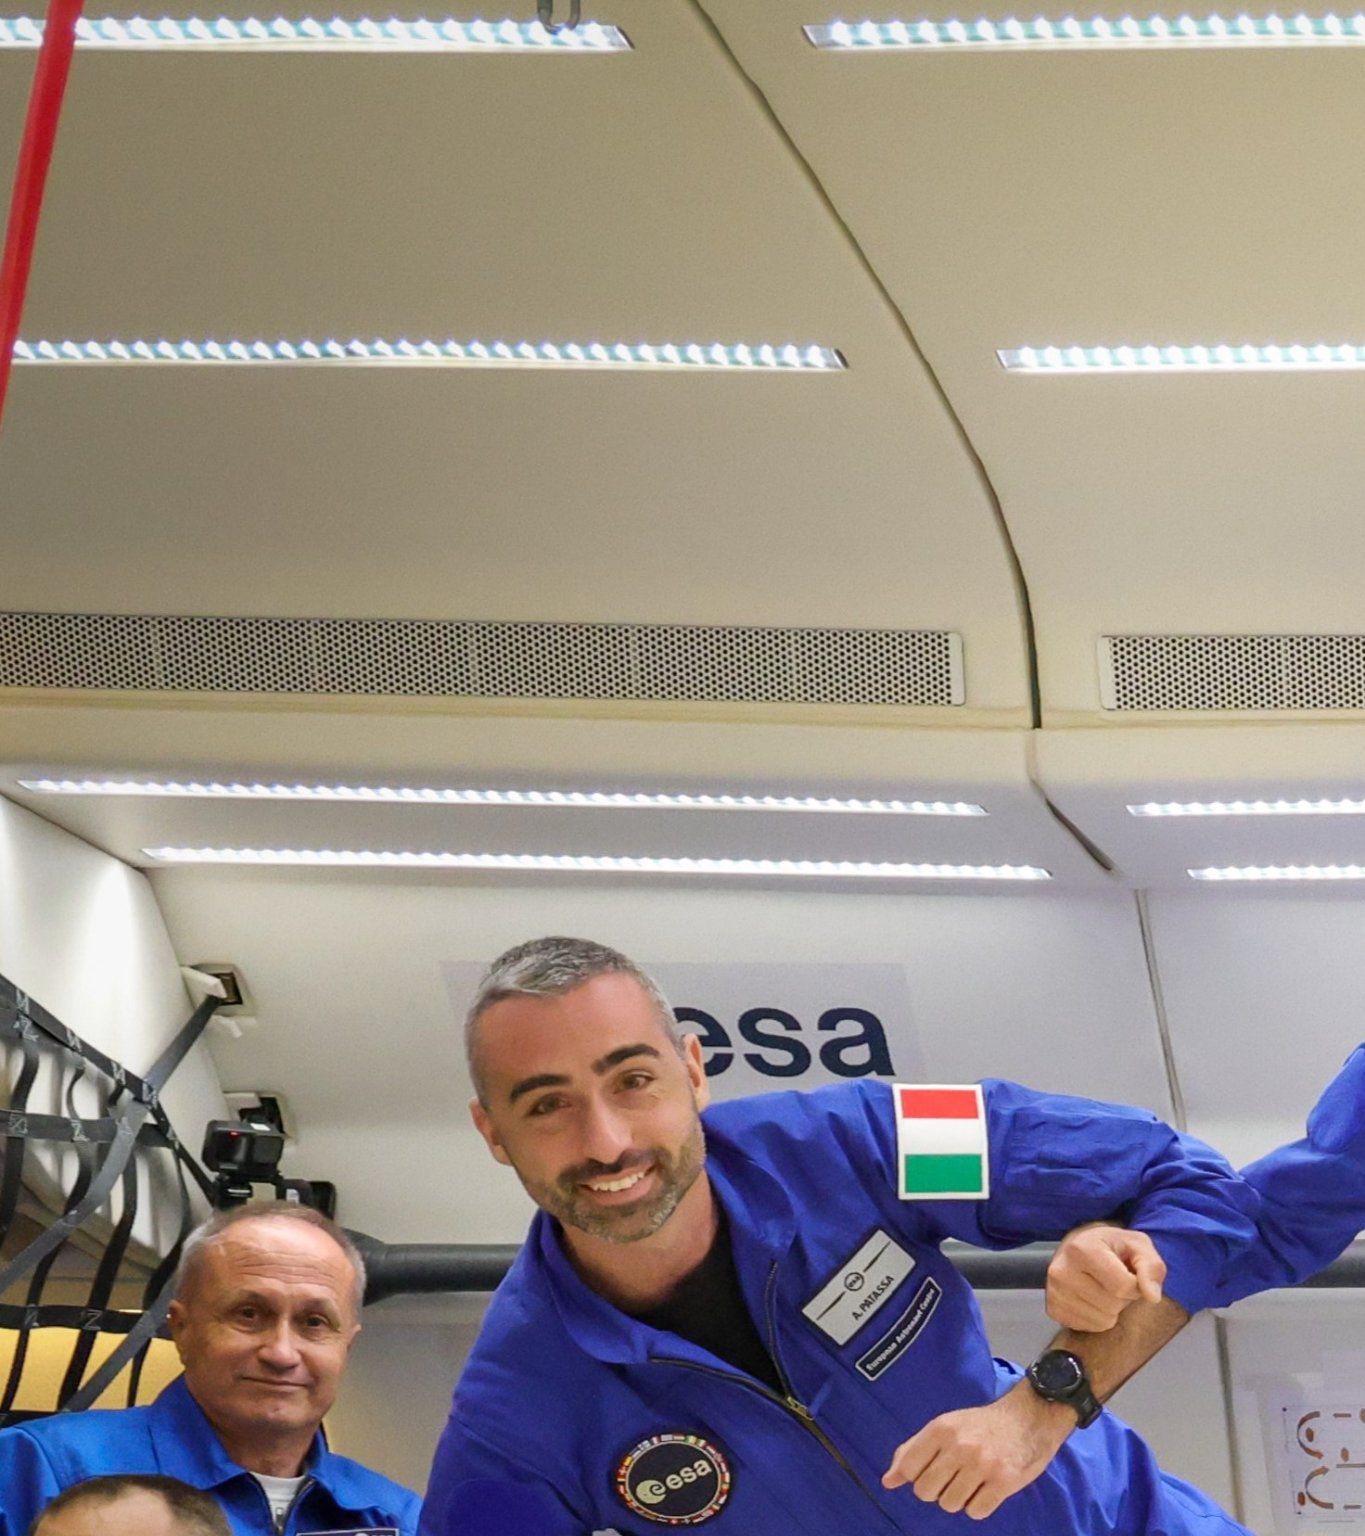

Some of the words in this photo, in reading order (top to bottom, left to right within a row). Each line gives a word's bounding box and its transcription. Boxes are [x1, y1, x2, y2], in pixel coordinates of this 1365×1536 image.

[673, 1007, 896, 1077] esa
[851, 1310, 863, 1321] A.
[860, 1275, 895, 1314] PATASSA
[665, 1459, 712, 1490] esa
